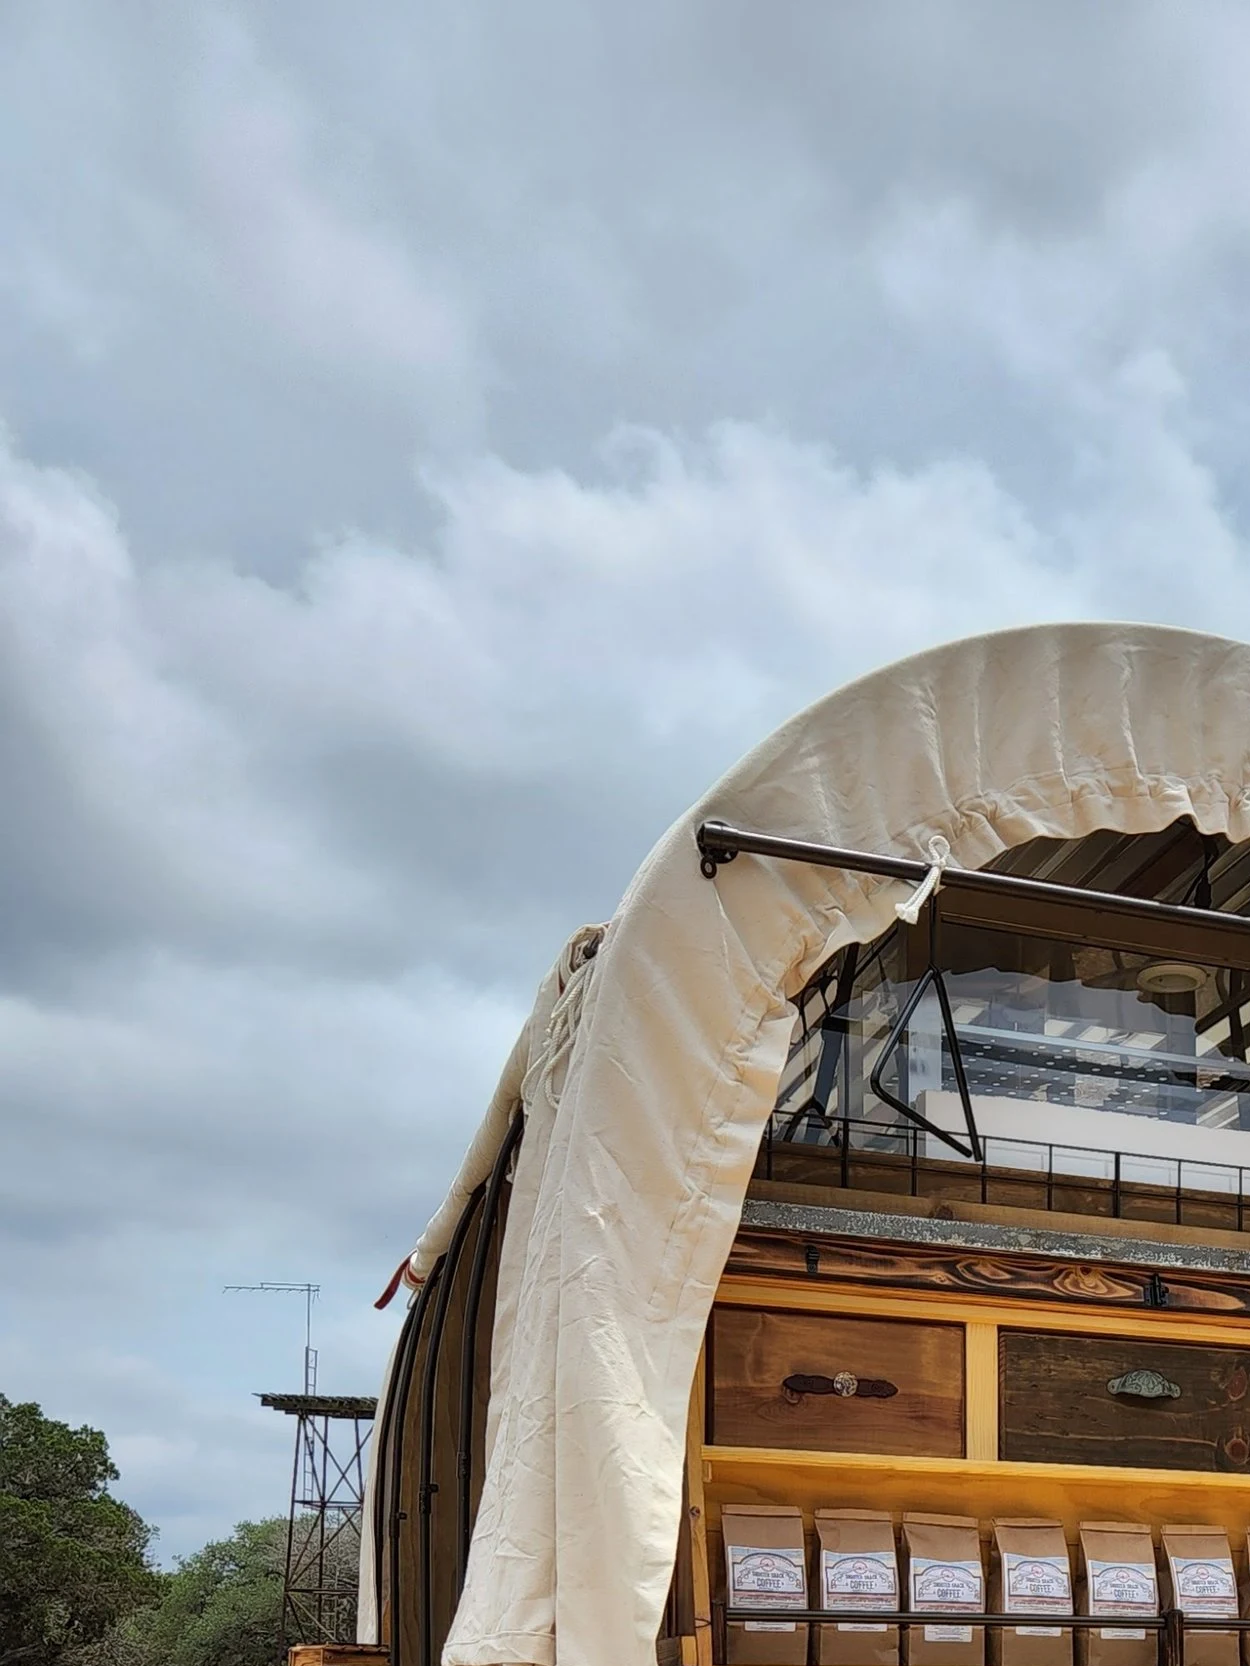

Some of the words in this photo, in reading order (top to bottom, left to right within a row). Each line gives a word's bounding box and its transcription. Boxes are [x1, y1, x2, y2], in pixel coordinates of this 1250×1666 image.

[756, 1578, 781, 1589] COFFEE
[850, 1580, 873, 1590] COFFEE
[1029, 1584, 1052, 1593] COFFEE
[937, 1589, 961, 1599] COFFEE
[1114, 1589, 1136, 1599] COFFEE
[1196, 1585, 1217, 1594] COFFEE
